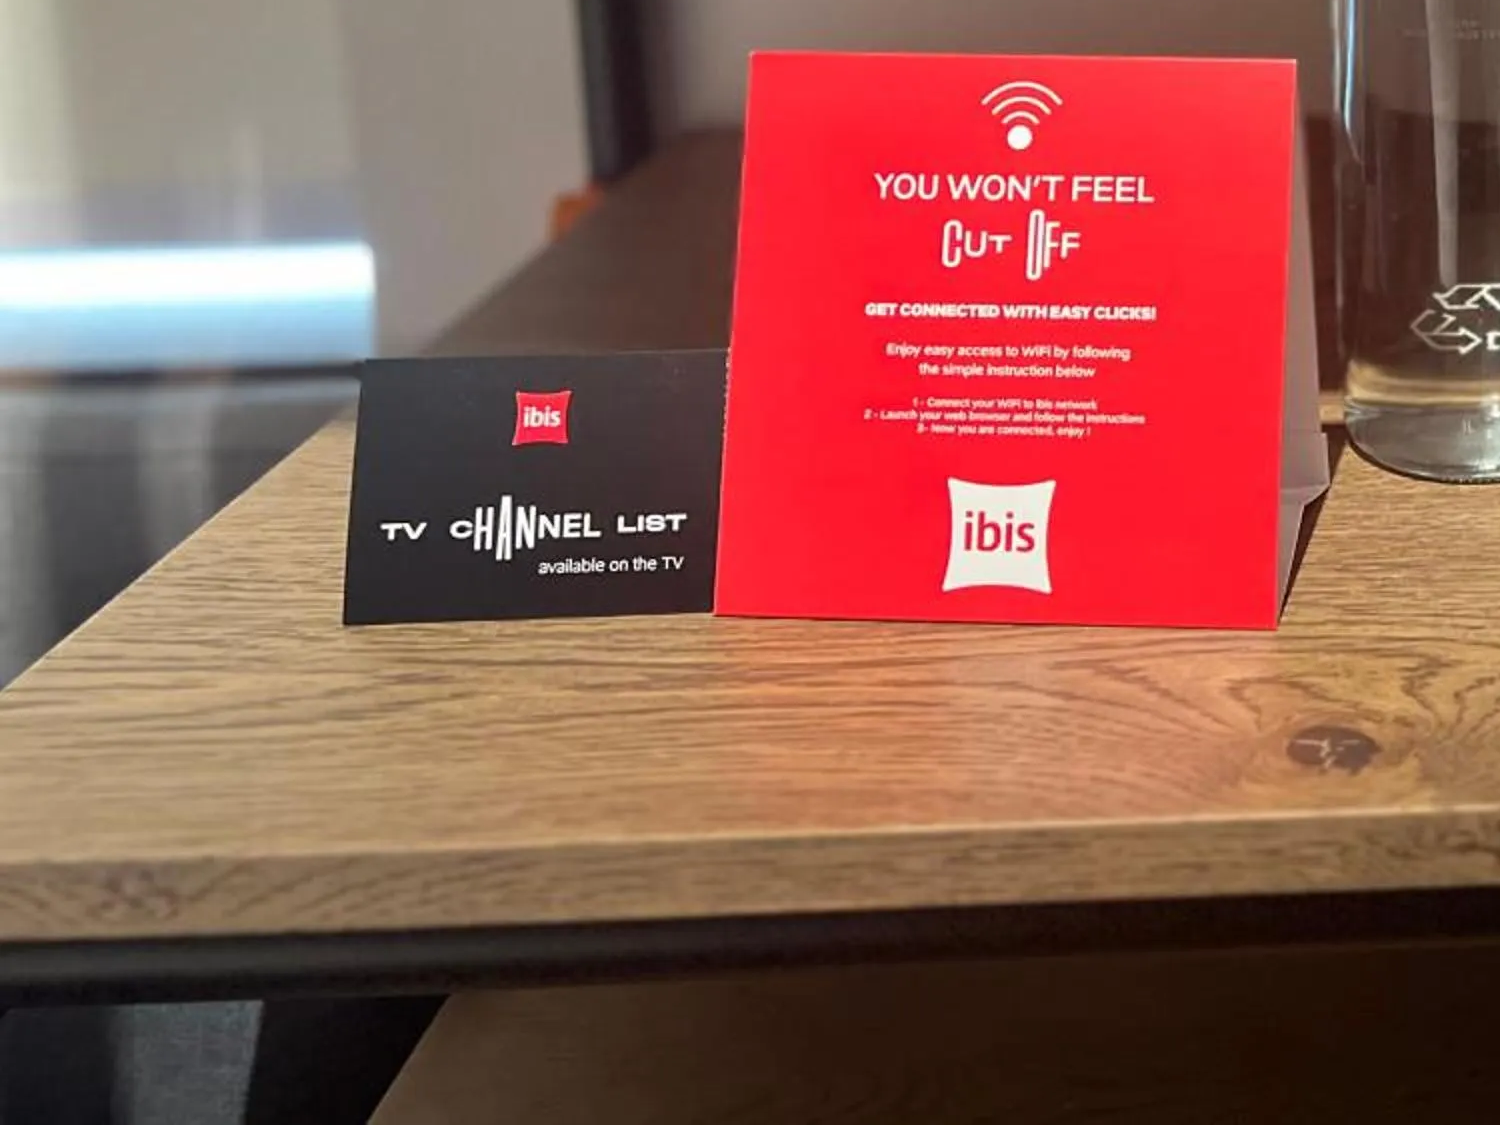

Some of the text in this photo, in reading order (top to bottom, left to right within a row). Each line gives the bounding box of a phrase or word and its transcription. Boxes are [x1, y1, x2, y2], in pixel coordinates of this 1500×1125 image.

[874, 173, 1155, 203] YOU WON'T FEEL
[941, 209, 1082, 281] CUT OFF
[865, 302, 1157, 321] GET CONNECTED WITH EASY CLICKS!
[885, 342, 921, 358] Enjoy
[923, 346, 955, 359] easy
[957, 346, 1003, 357] access
[1005, 345, 1019, 357] to
[1053, 345, 1070, 360] by
[1072, 345, 1131, 362] following
[918, 362, 1096, 378] the simple instruction below
[926, 396, 970, 408] Connect
[971, 398, 995, 410] your
[1023, 398, 1034, 409] to
[1055, 398, 1098, 410] network
[523, 405, 561, 429] ibis
[880, 409, 918, 420] Launch
[919, 410, 942, 421] your
[944, 410, 967, 421] web
[968, 411, 1011, 422] browser
[1012, 411, 1032, 422] and
[1034, 411, 1066, 423] follow
[1067, 412, 1085, 423] the
[957, 424, 977, 436] you
[977, 425, 995, 435] are
[1056, 425, 1085, 439] enjoy
[380, 521, 427, 541] TV
[616, 513, 688, 534] LIST
[962, 510, 1036, 554] ibis
[538, 555, 685, 574] available on the TV
